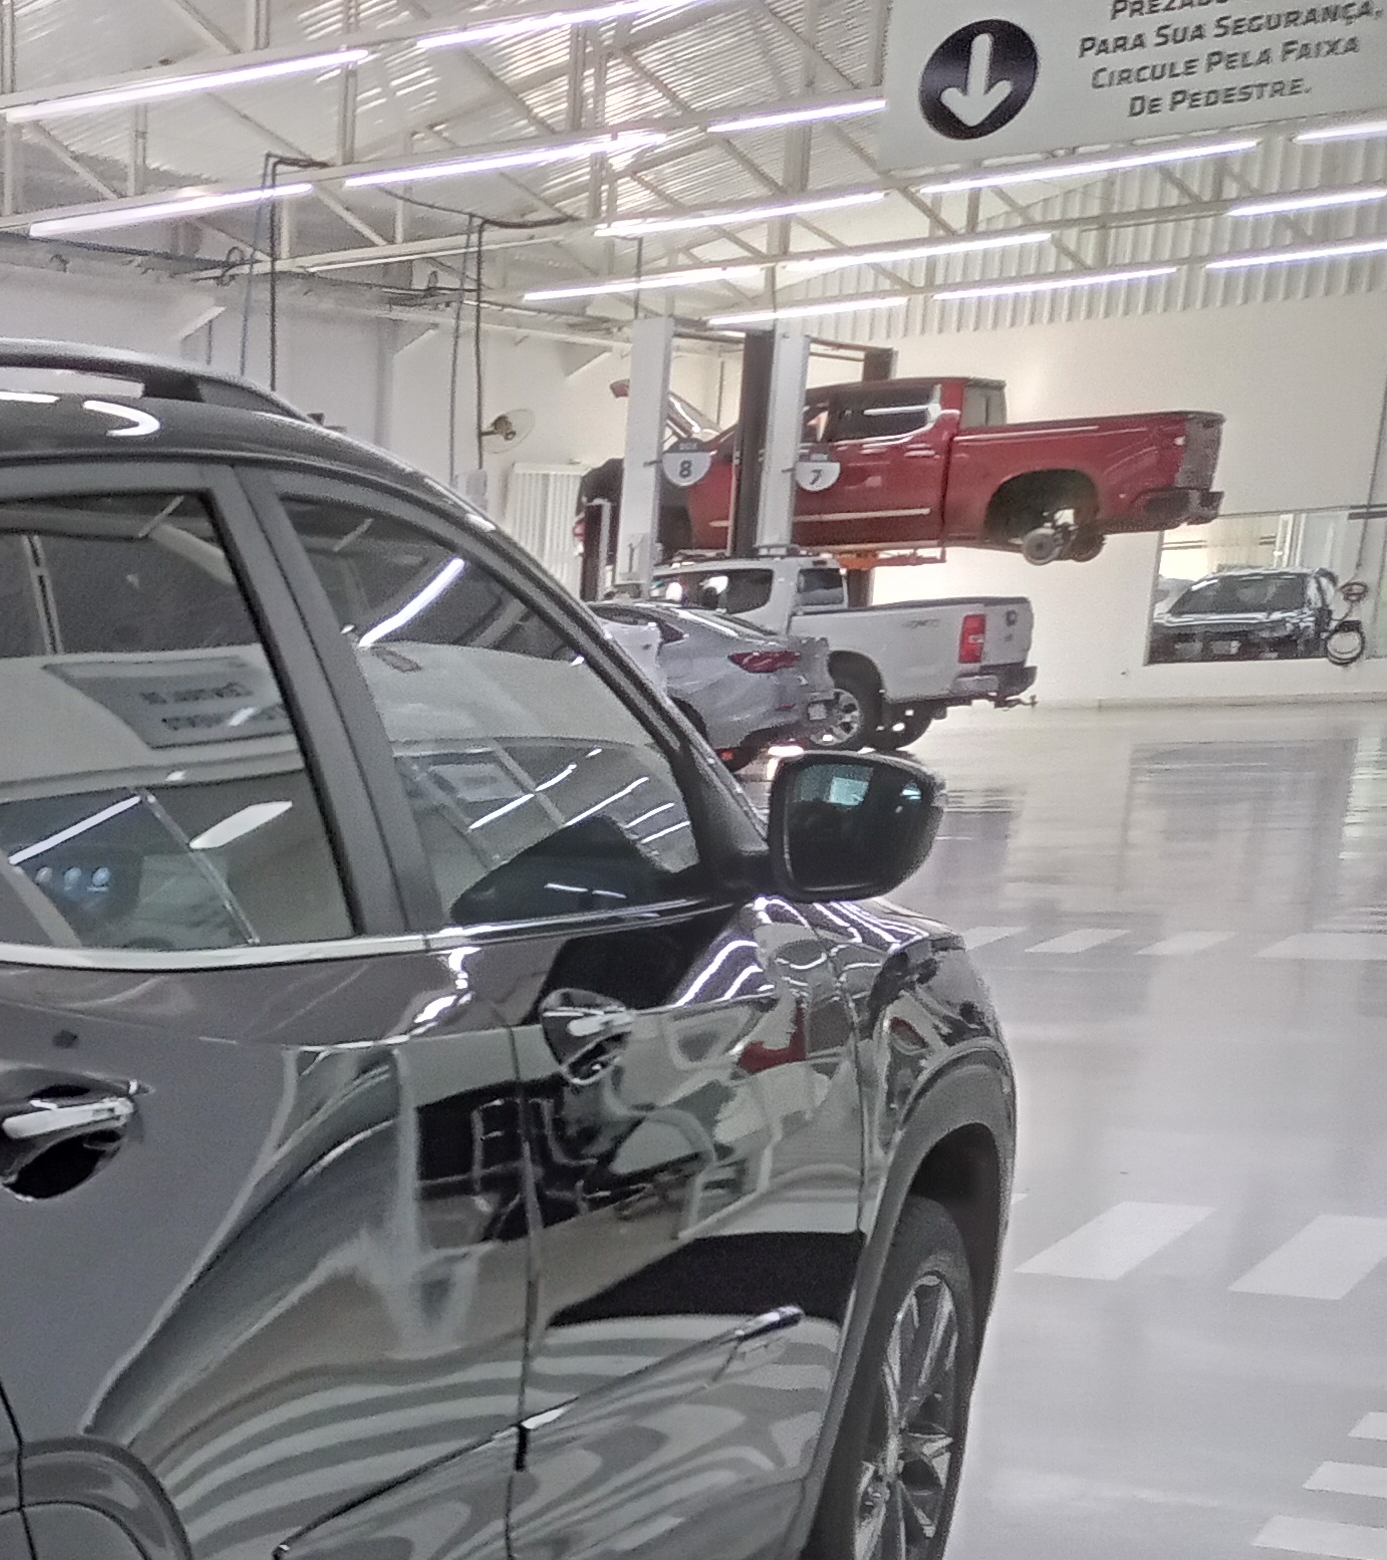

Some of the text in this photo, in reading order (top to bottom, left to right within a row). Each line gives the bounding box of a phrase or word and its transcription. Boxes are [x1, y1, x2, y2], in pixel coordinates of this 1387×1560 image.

[1078, 33, 1147, 58] PARA
[1153, 23, 1207, 47] SUA
[1091, 36, 1360, 89] CIRCULE PELA FAIXA
[1128, 95, 1163, 118] DE
[679, 460, 693, 478] 8
[809, 469, 823, 485] 7
